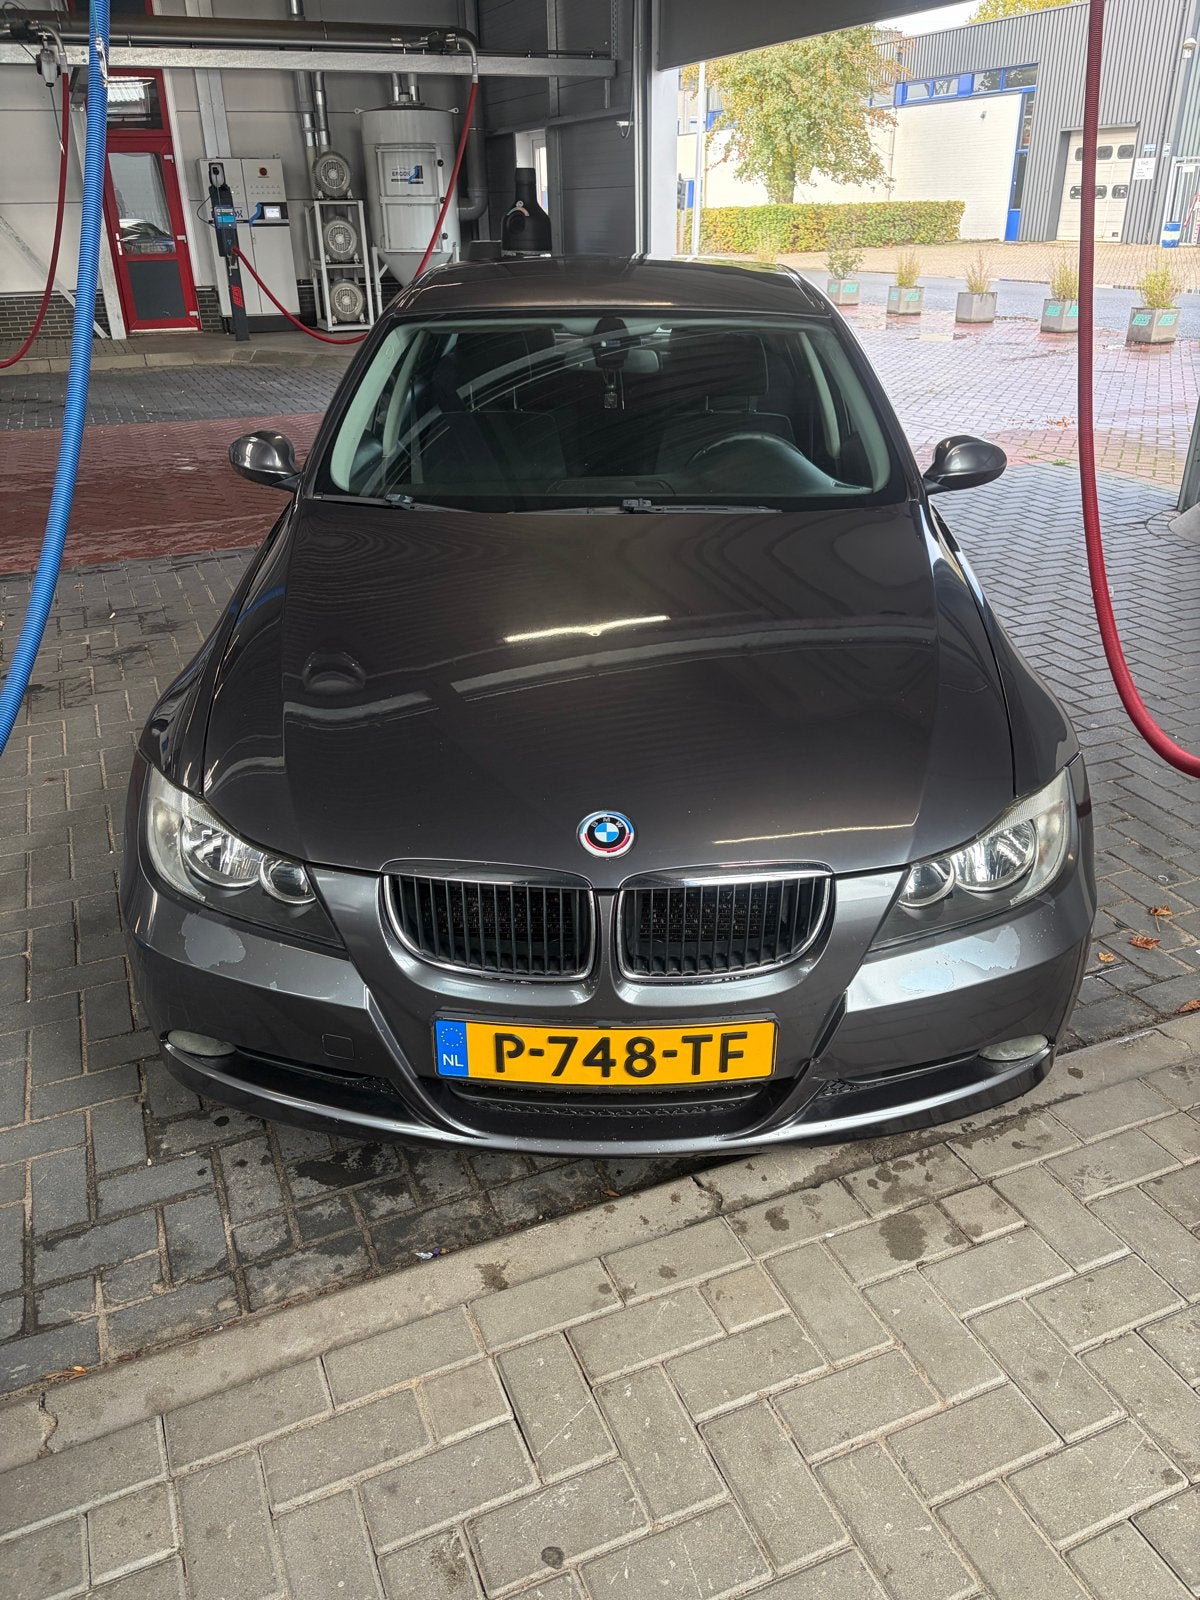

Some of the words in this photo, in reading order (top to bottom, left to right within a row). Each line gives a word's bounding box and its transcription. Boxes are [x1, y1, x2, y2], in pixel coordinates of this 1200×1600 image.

[591, 817, 623, 828] BMW
[442, 1053, 464, 1067] NL
[494, 1031, 748, 1078] P-748-TF
